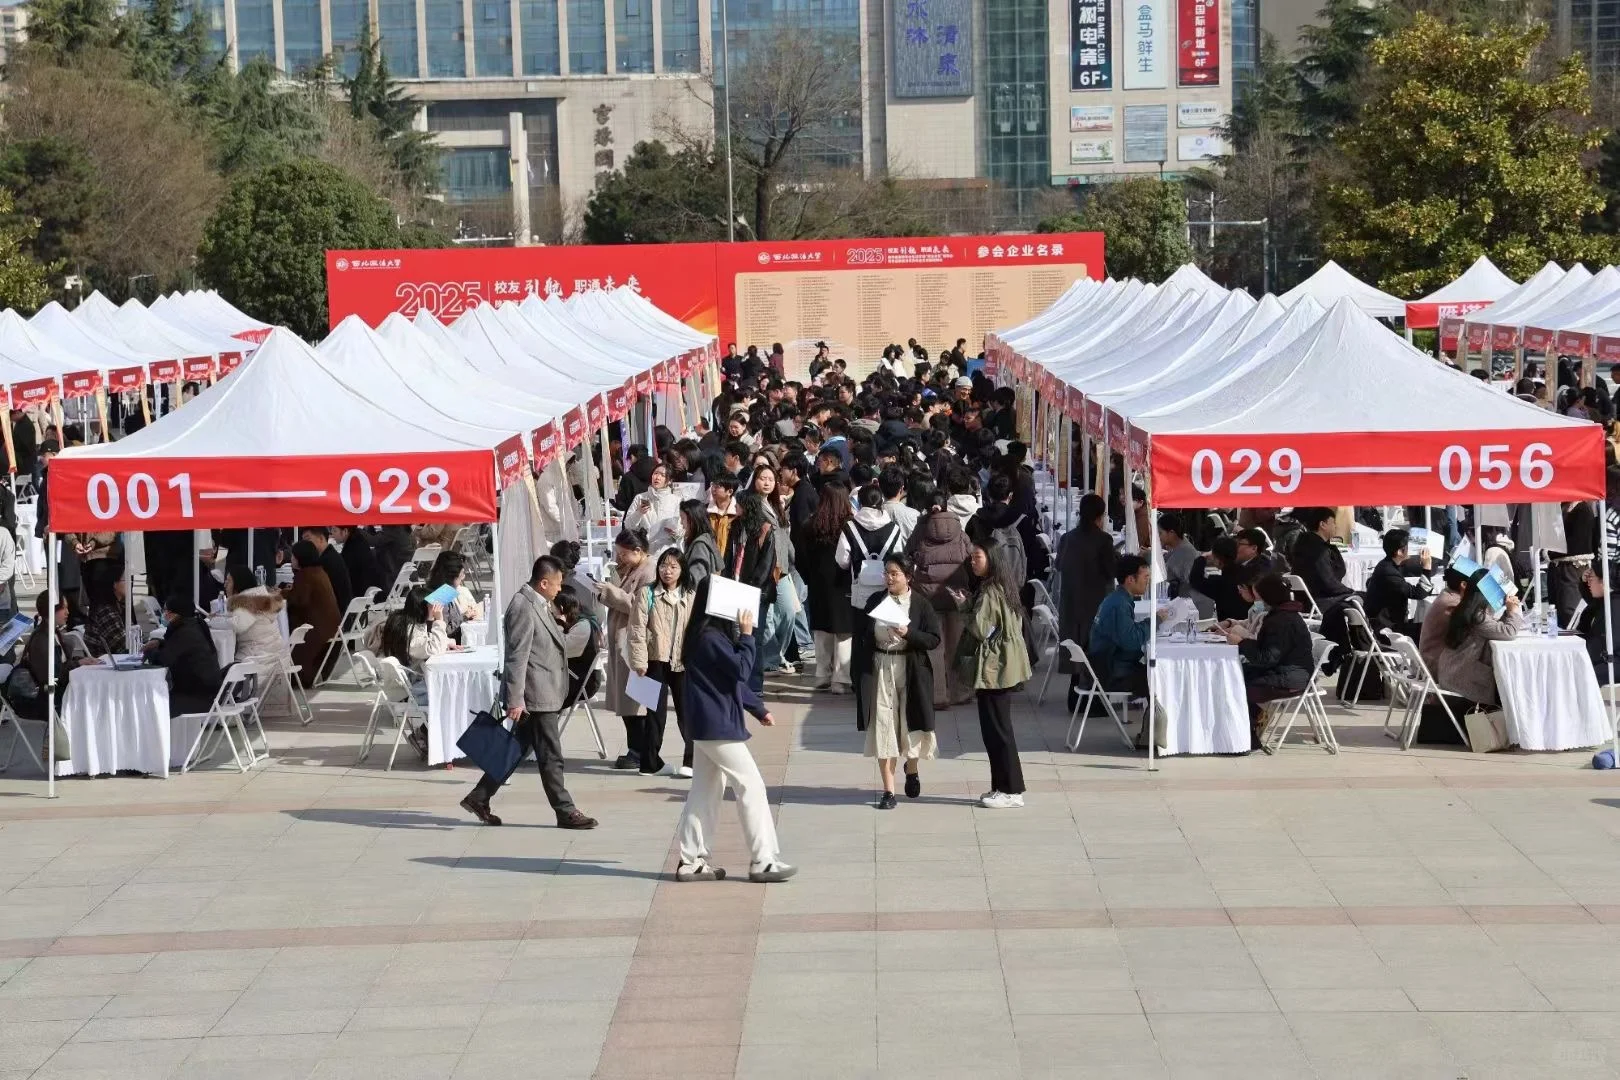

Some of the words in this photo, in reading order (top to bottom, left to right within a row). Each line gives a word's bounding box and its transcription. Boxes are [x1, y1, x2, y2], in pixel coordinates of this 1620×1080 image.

[1097, 16, 1105, 39] GAME
[1136, 4, 1153, 73] 盒马鲜生
[1097, 43, 1105, 65] CLUB
[1195, 58, 1206, 67] 6F
[1080, 71, 1101, 86] 6F
[846, 247, 884, 264] 2025
[977, 243, 1064, 258] 参会企业名录
[396, 281, 484, 318] 2025
